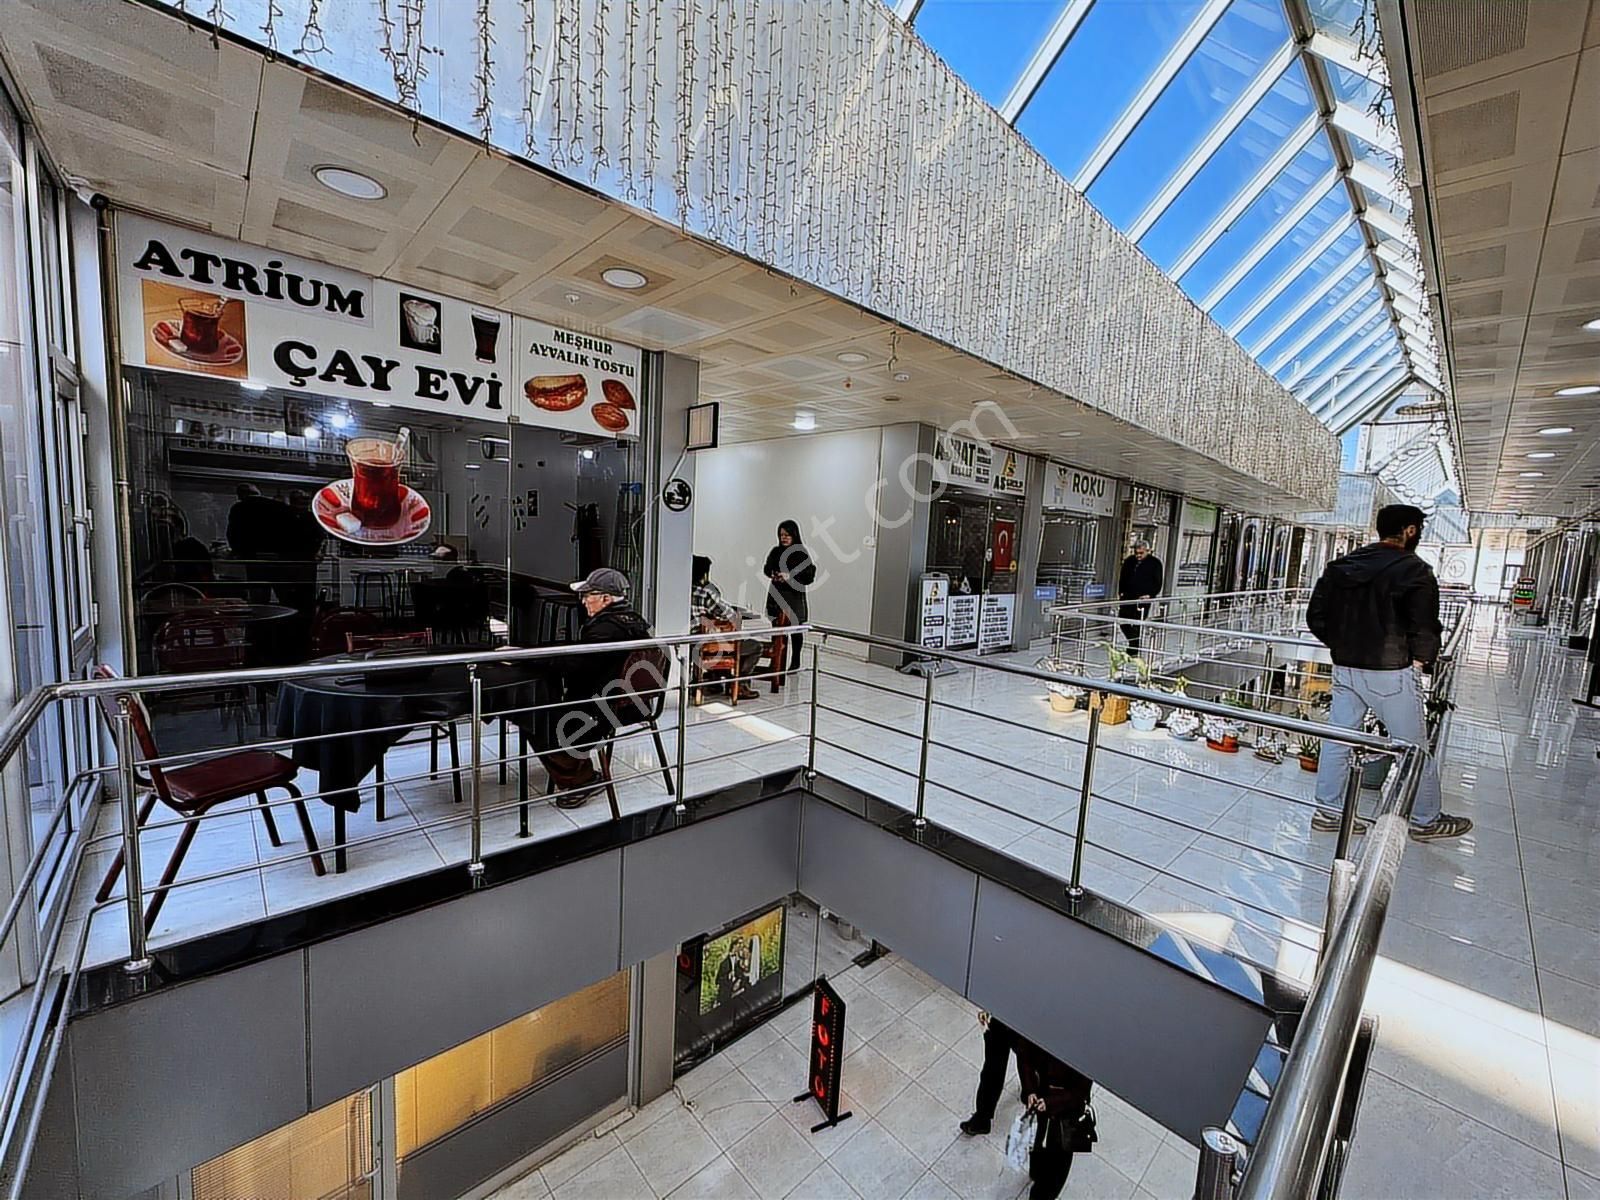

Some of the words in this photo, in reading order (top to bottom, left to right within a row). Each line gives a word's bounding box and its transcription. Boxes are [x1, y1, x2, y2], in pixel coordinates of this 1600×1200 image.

[133, 239, 365, 318] ATRİUM
[529, 343, 589, 366] AYVALIK
[593, 357, 634, 377] TOSTU
[553, 330, 613, 355] MEŞHUR
[273, 341, 400, 391] ÇAY
[415, 365, 503, 410] EVİ
[1072, 473, 1105, 497] ROKU
[814, 997, 830, 1098] FOTO
